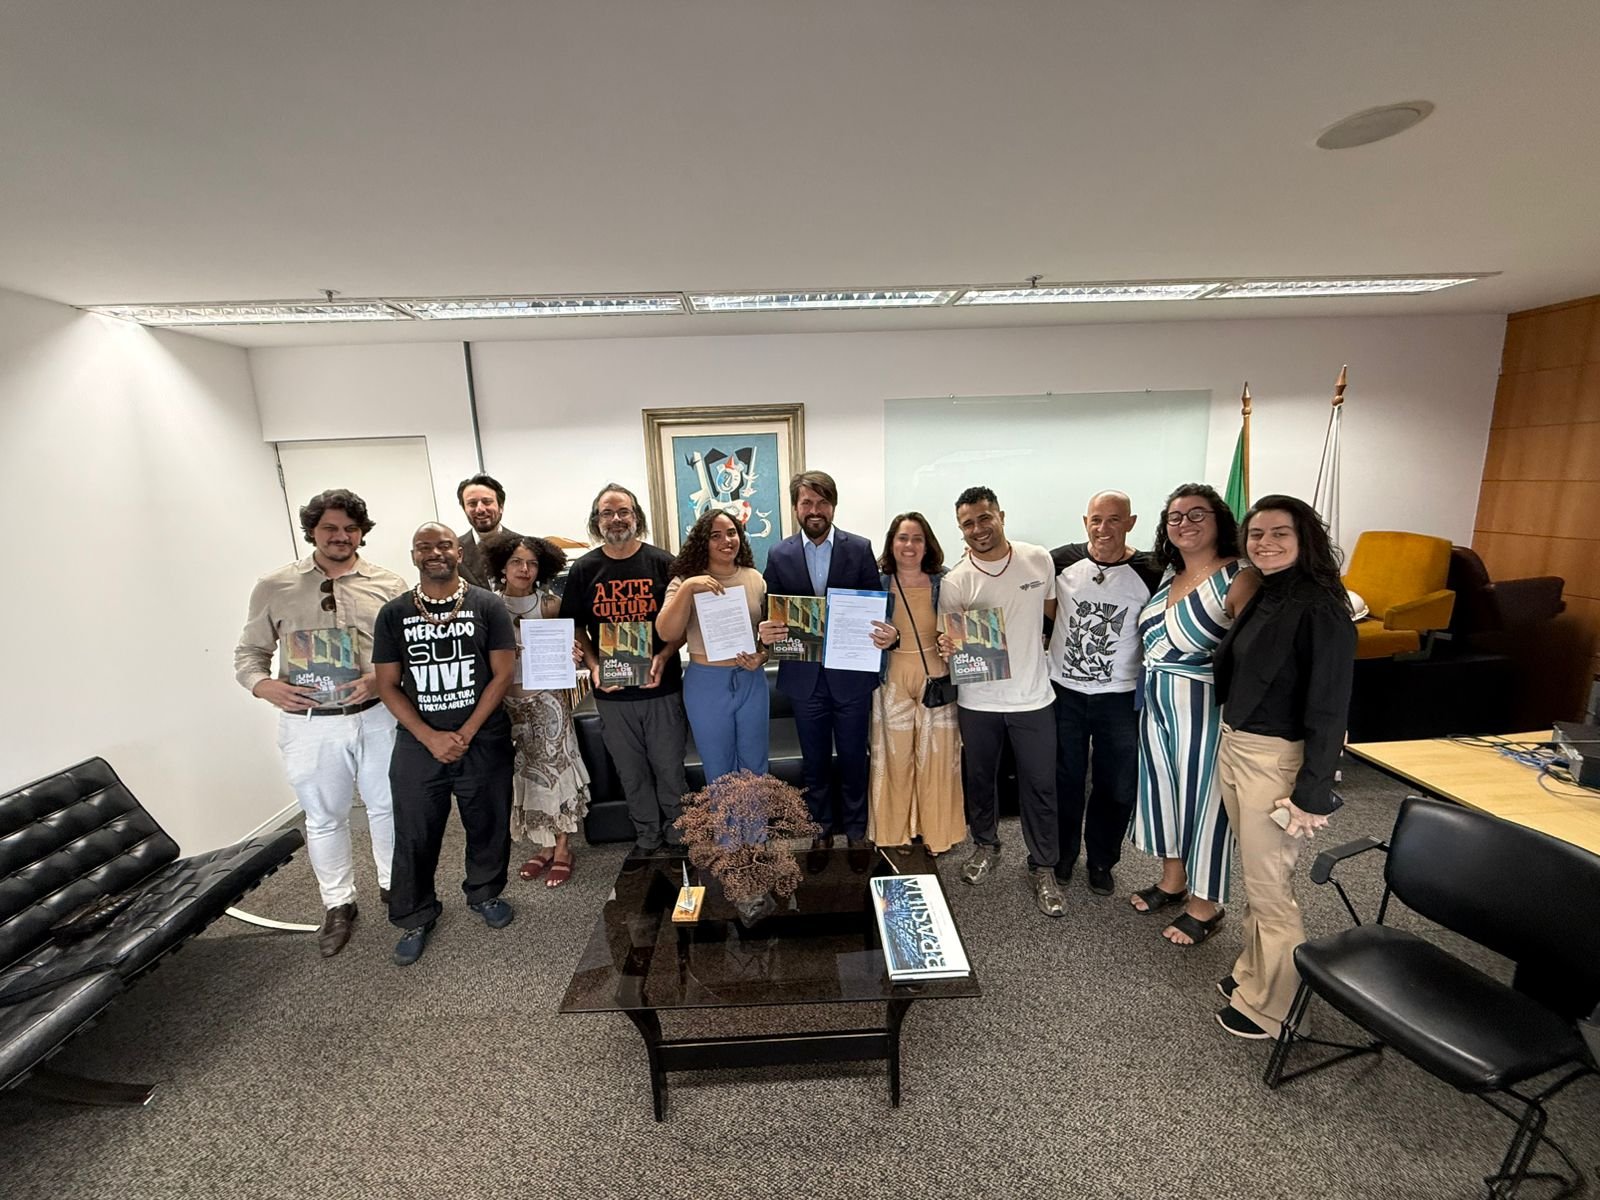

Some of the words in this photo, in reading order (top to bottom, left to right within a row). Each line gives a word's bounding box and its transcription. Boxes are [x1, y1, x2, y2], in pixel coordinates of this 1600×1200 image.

[593, 579, 653, 603] ARTE
[592, 599, 657, 617] CULTURA
[404, 622, 475, 642] MERCADO
[407, 639, 476, 664] SUL
[409, 659, 475, 692] VIVE
[432, 694, 442, 702] DA
[443, 689, 475, 702] CULTURA
[448, 698, 475, 710] ABERTAS
